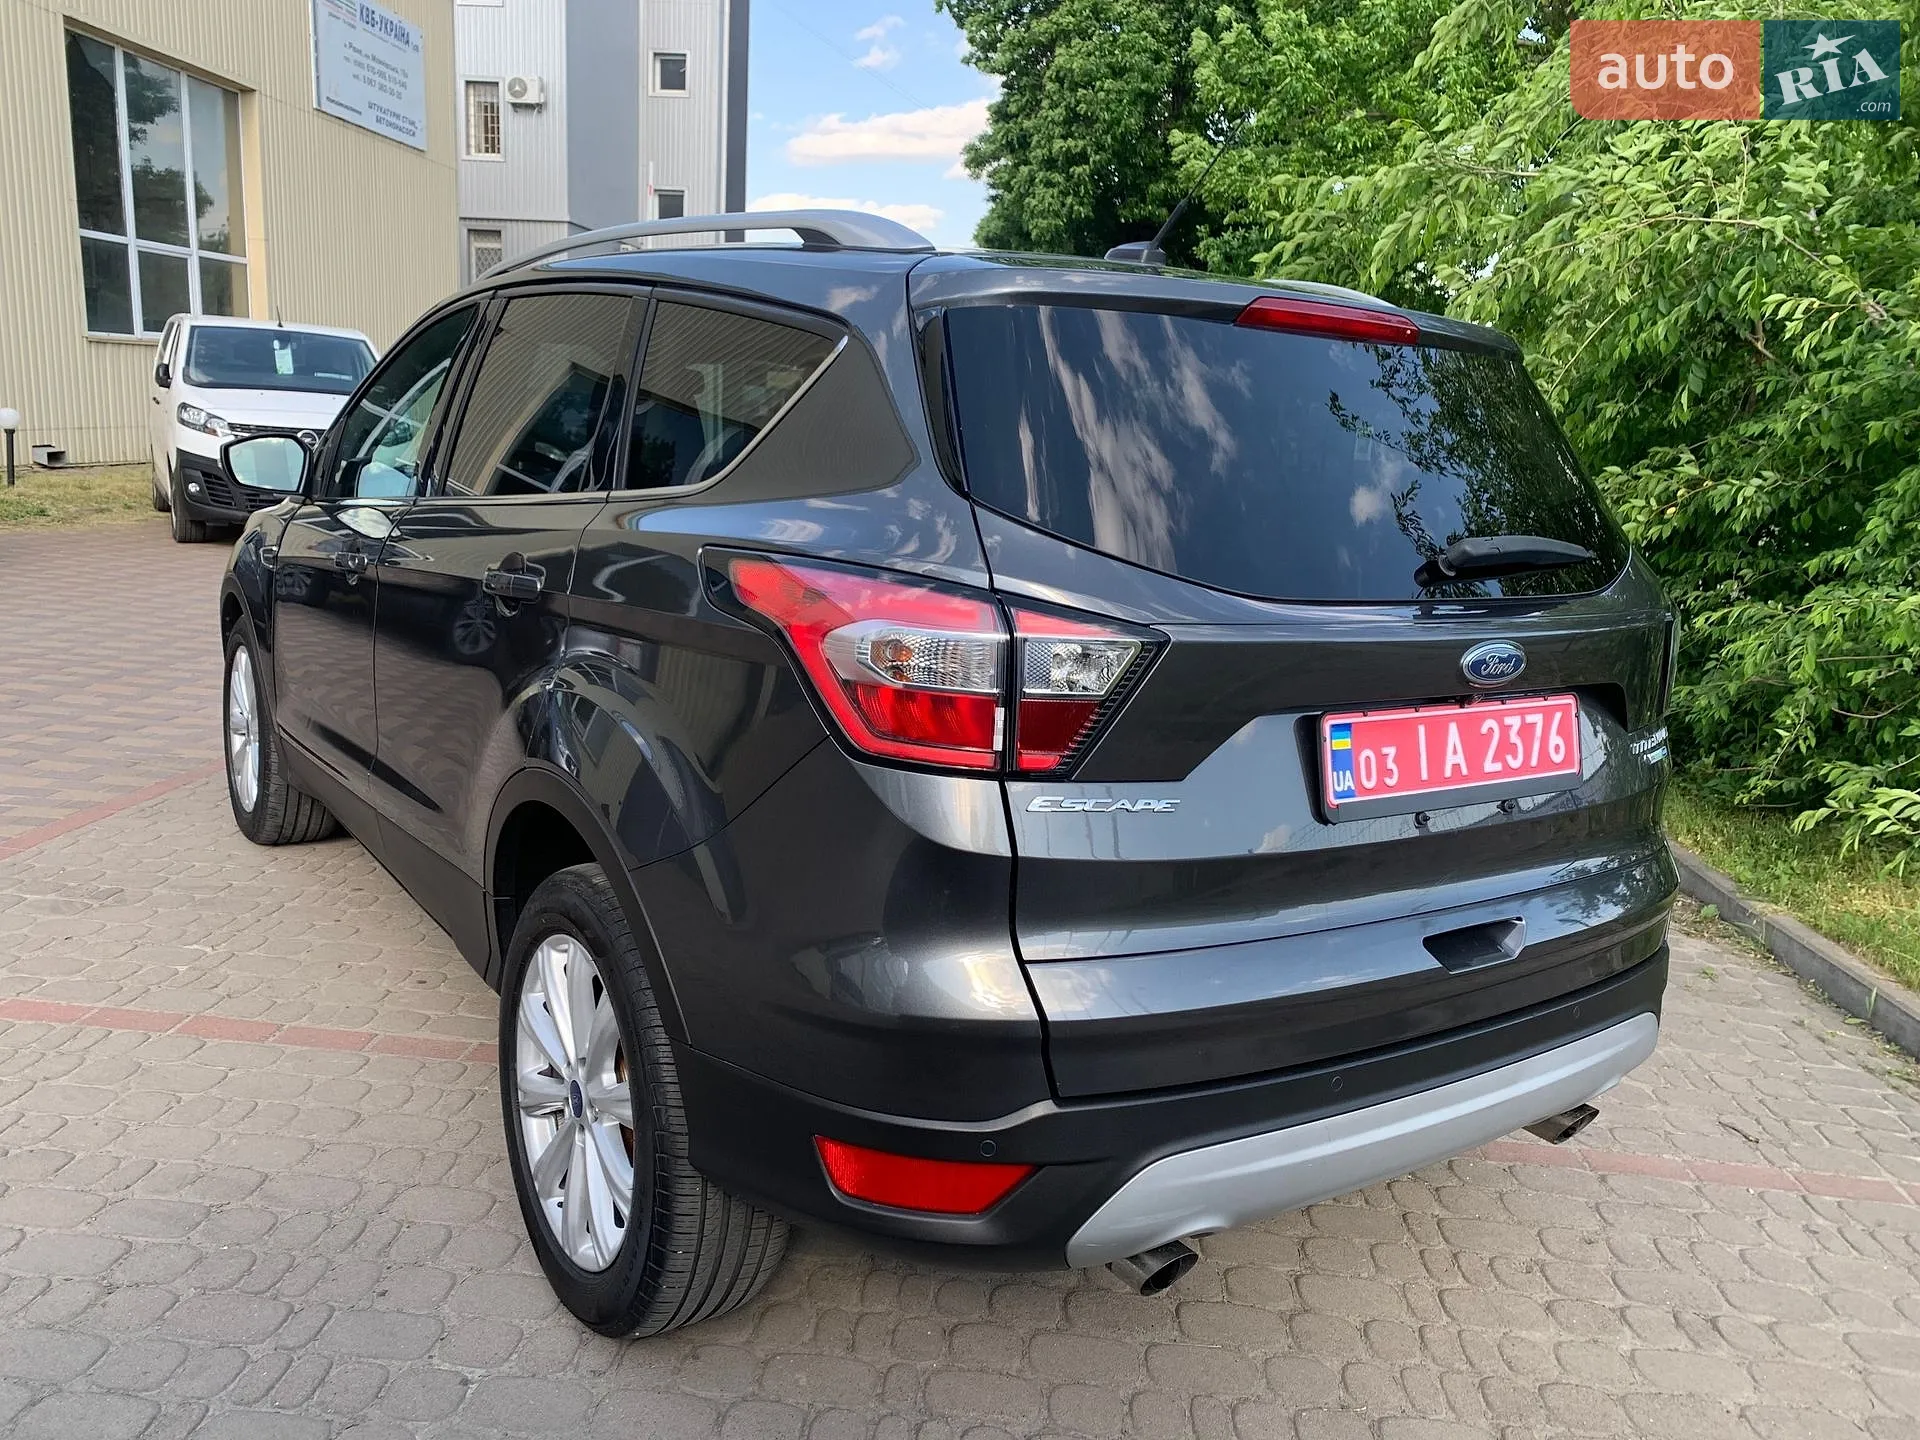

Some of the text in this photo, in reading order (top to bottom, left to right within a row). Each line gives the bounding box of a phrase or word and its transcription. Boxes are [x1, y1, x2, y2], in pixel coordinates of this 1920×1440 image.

[359, 3, 410, 47] КВБ-УКРАЇНА
[1480, 652, 1516, 676] Ford
[1359, 746, 1400, 791] 03
[1479, 710, 1567, 774] 2376
[1333, 769, 1355, 792] UA
[1026, 795, 1181, 813] ESCAPE
